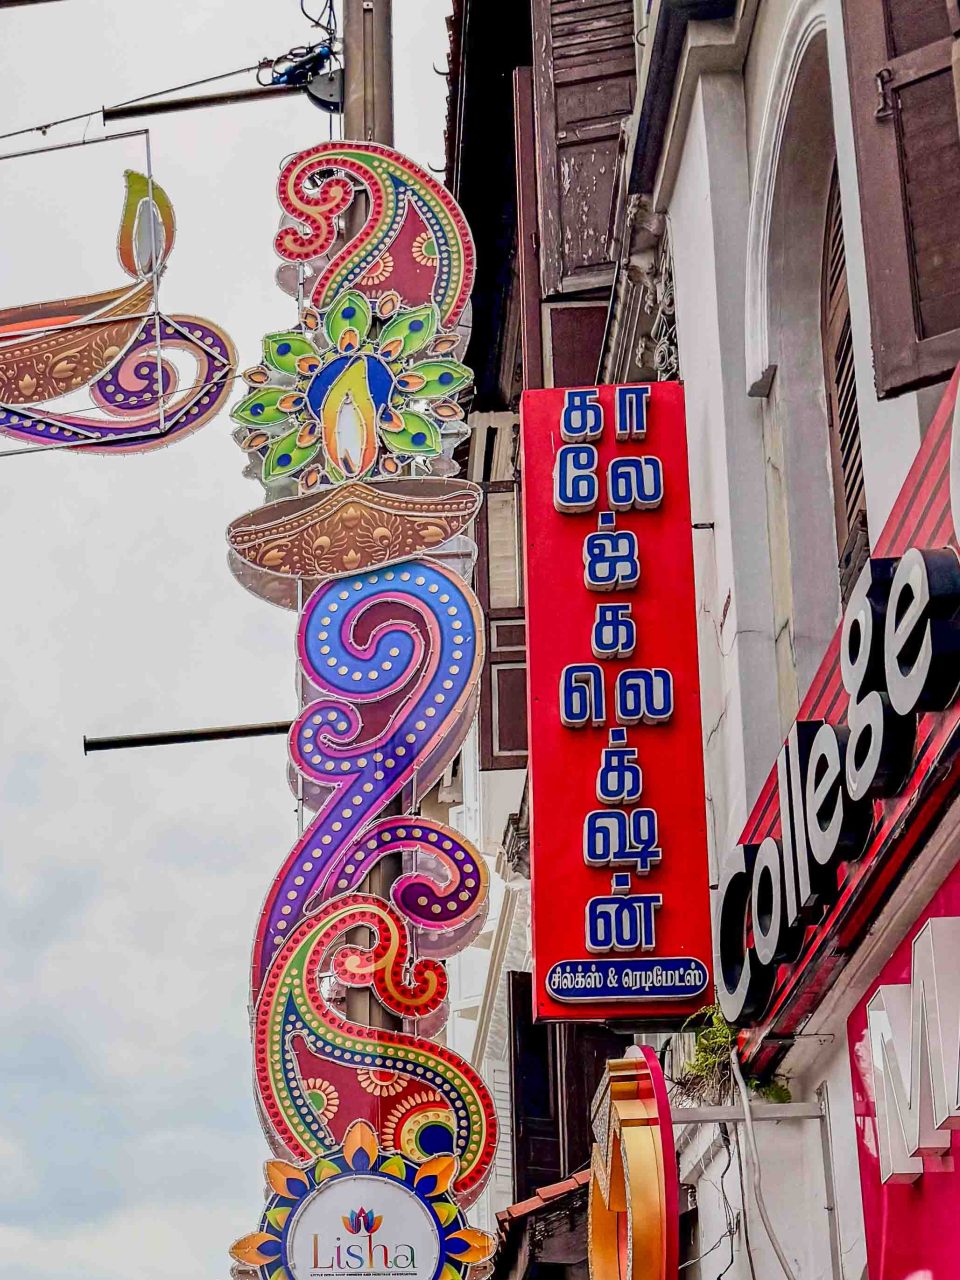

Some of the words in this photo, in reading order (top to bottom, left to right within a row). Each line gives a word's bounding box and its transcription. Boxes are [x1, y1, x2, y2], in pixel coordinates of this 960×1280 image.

[713, 547, 934, 1023] College
[607, 967, 619, 988] &
[309, 1233, 418, 1270] Lisha
